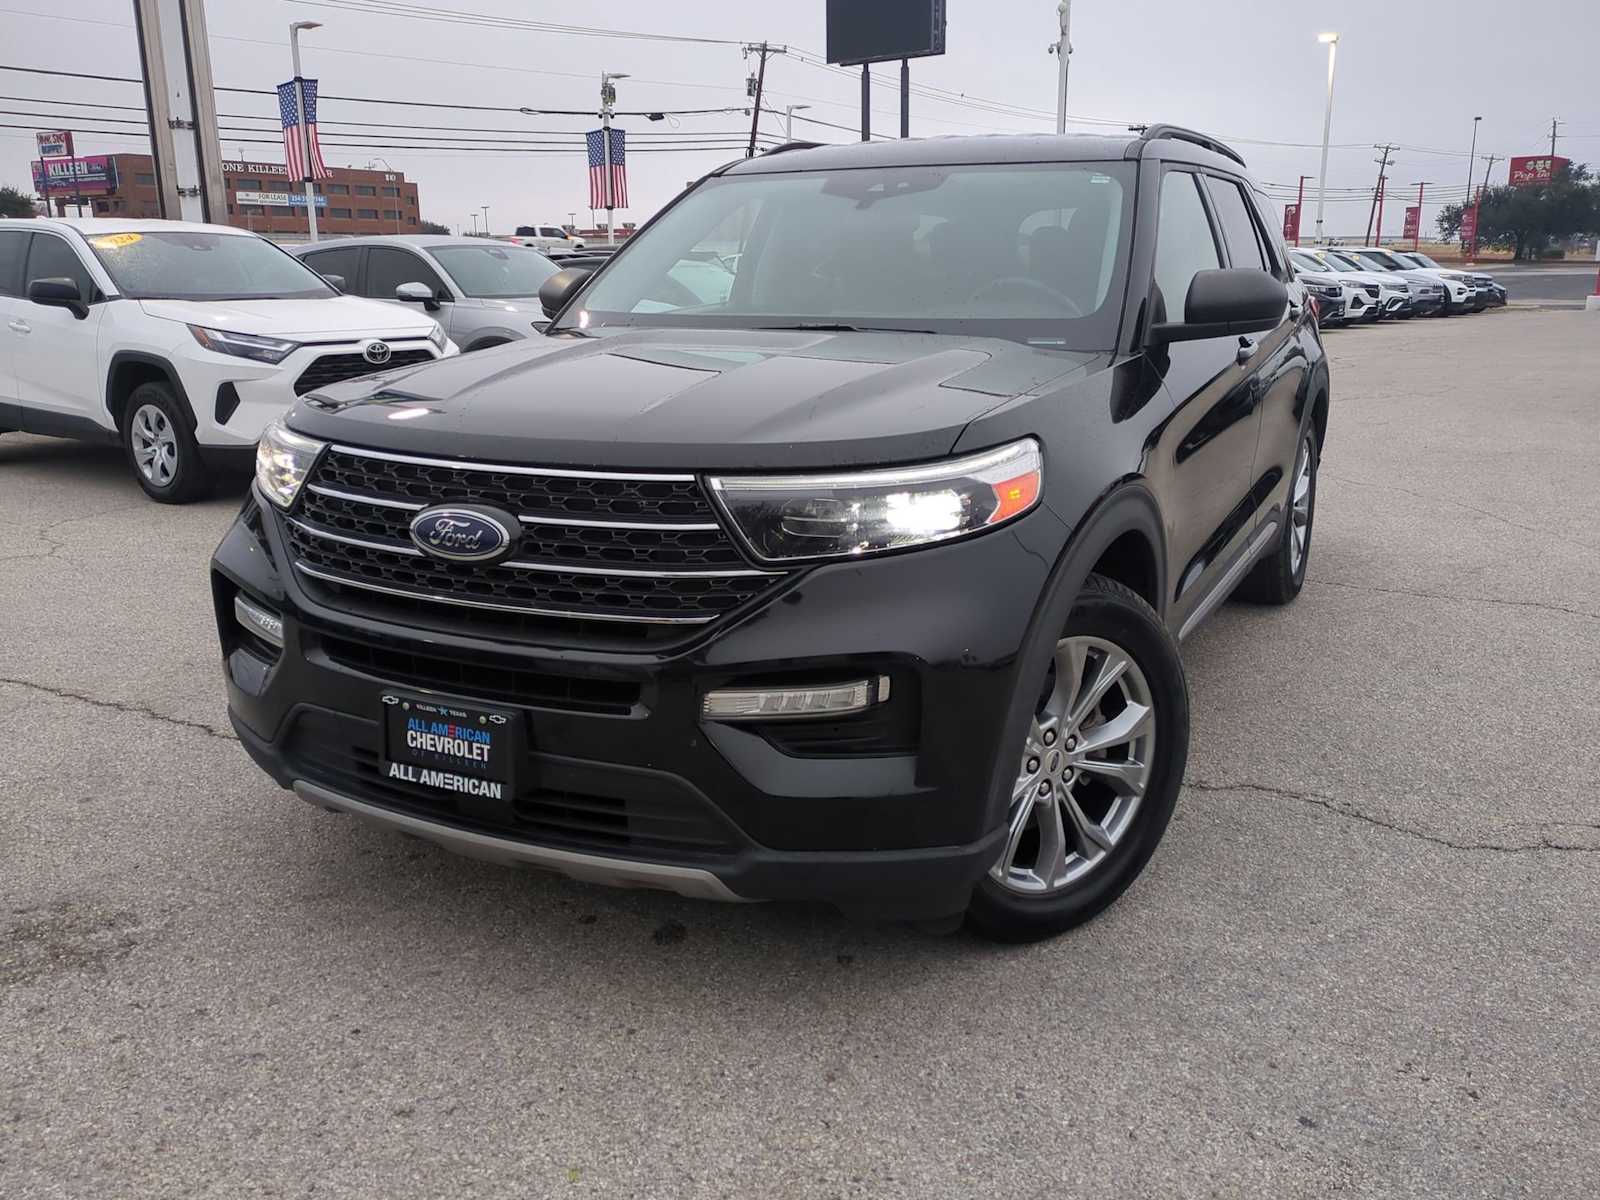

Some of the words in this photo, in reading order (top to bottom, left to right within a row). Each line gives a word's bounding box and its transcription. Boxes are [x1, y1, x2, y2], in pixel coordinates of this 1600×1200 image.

[222, 163, 244, 172] ONE
[271, 193, 287, 201] LEASE
[429, 518, 484, 550] Ford
[408, 718, 429, 733] ALL
[431, 722, 490, 744] AMERICAN
[407, 730, 491, 762] CHEVROLET
[389, 762, 417, 782] ALL
[420, 769, 502, 800] AMERICAN
